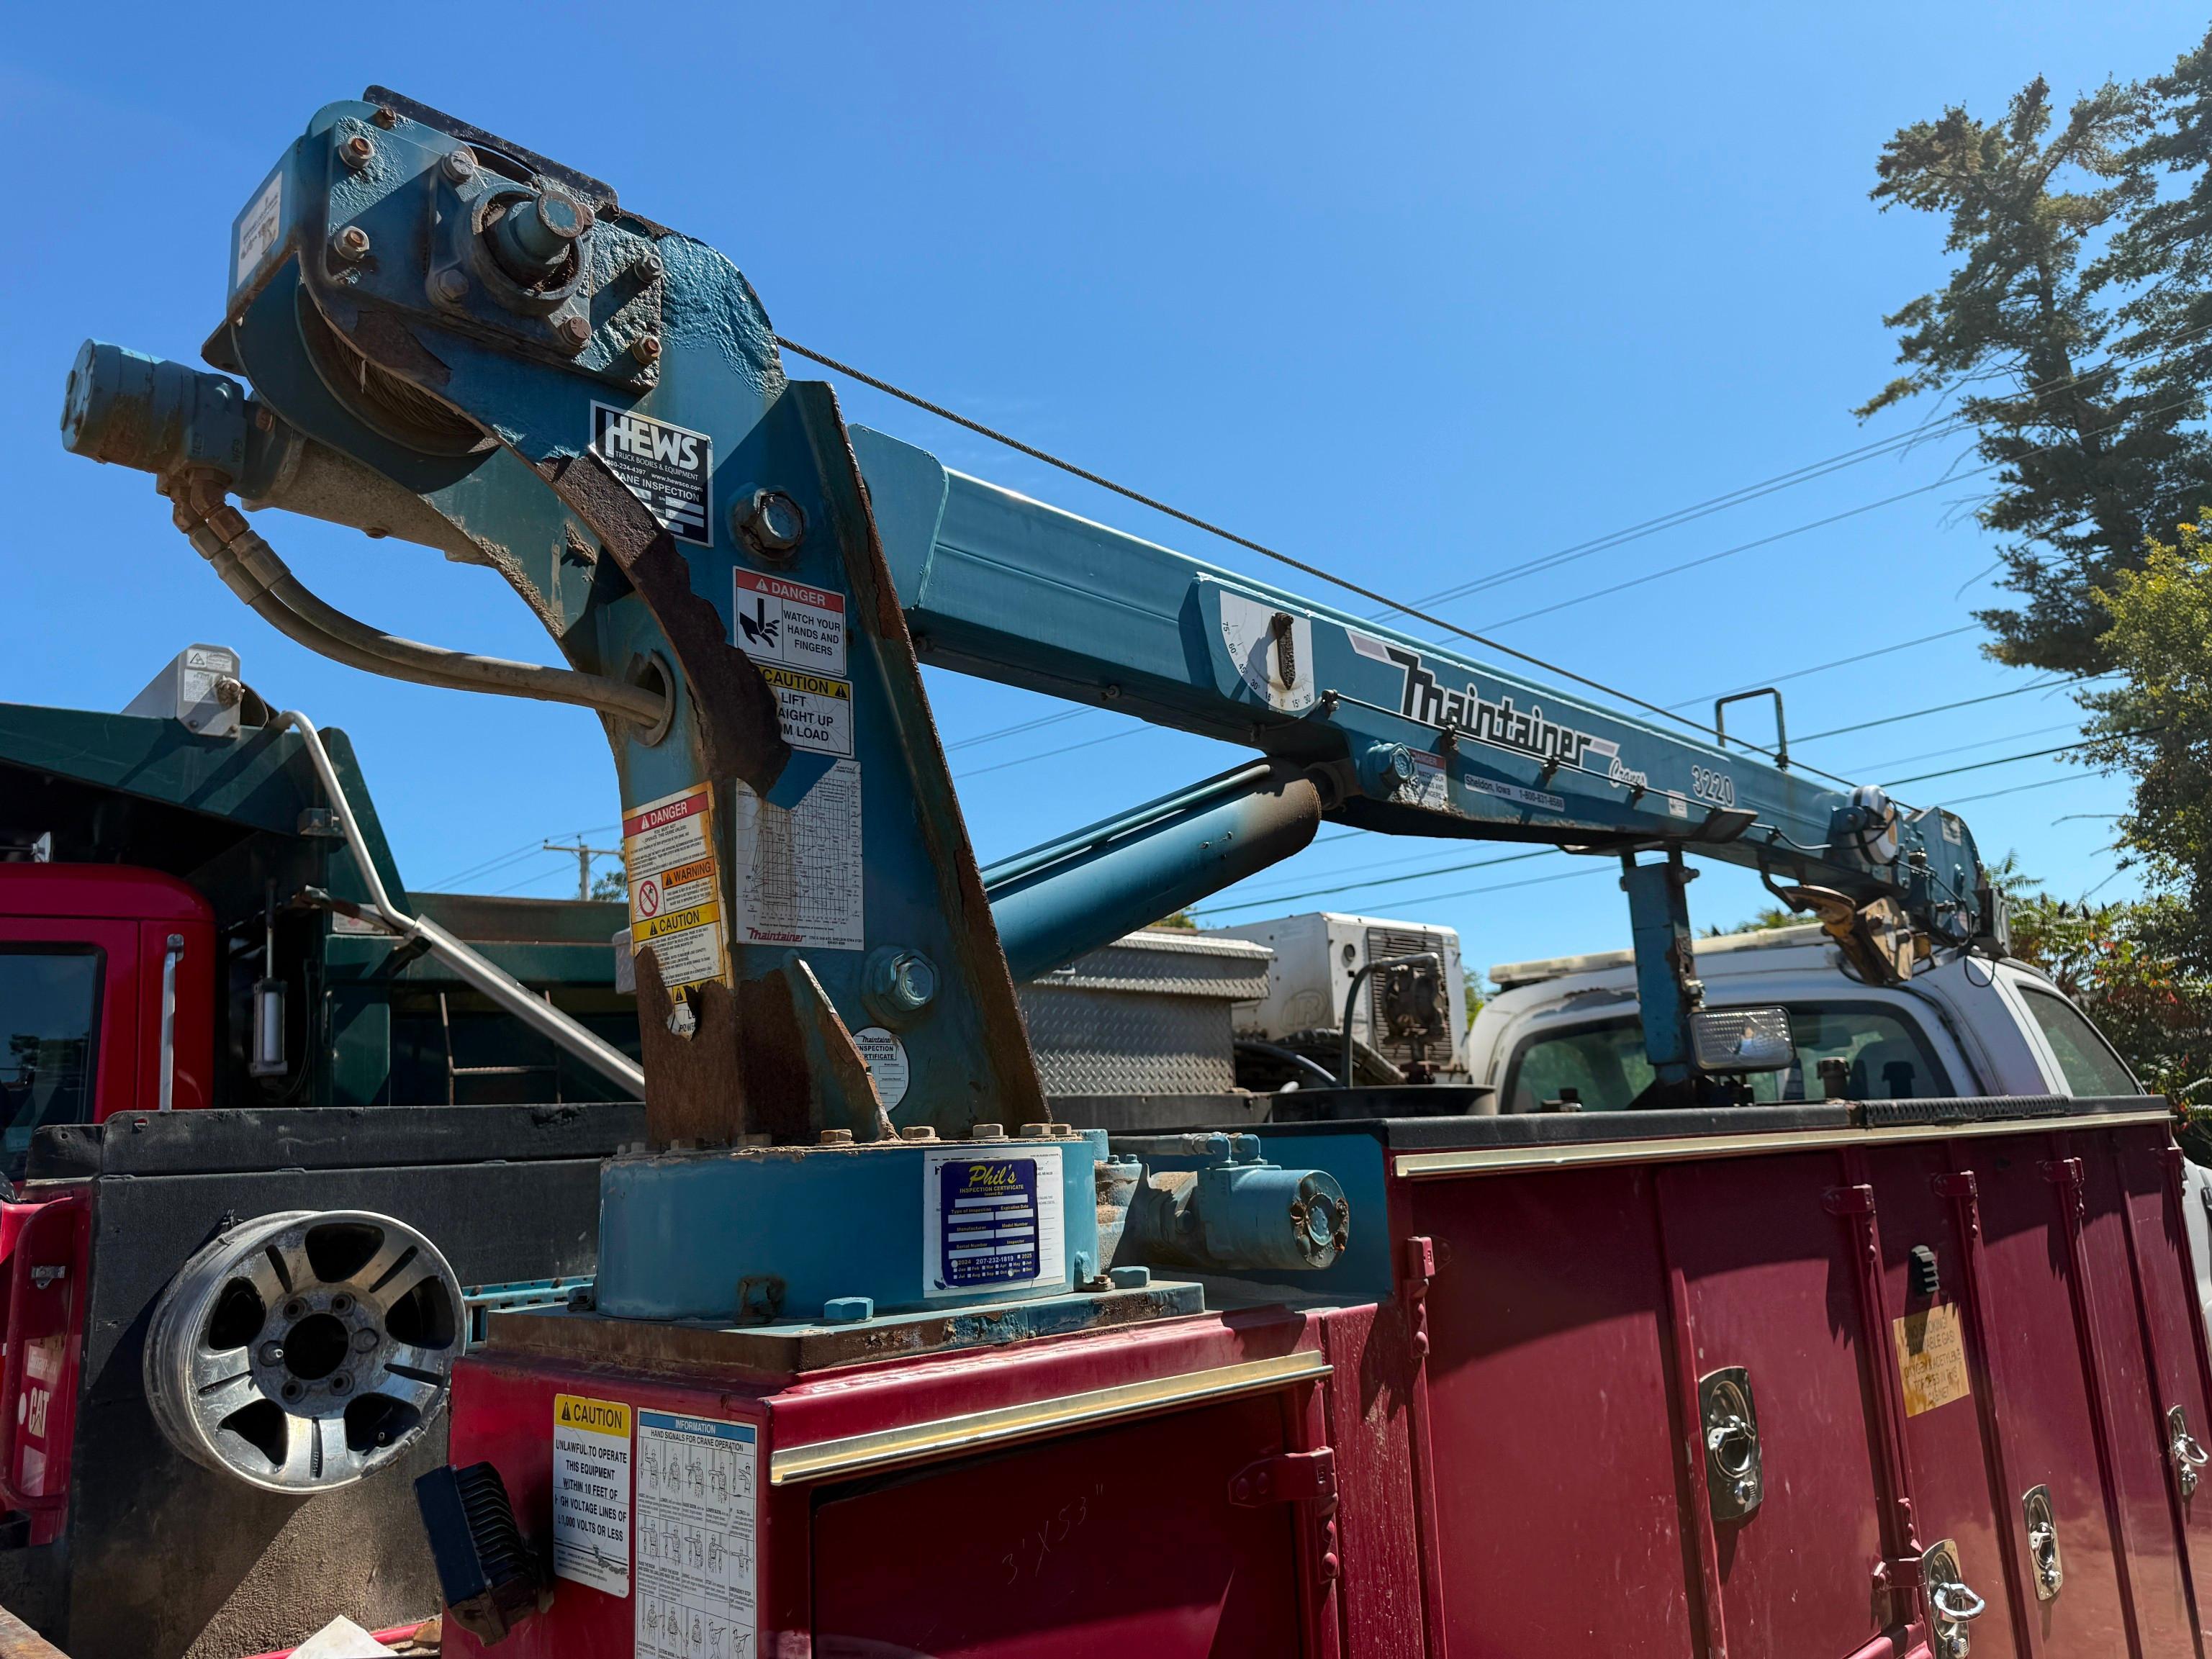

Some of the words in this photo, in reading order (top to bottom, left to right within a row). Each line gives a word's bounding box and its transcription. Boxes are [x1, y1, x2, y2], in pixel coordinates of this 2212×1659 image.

[605, 412, 699, 470] HEWS
[615, 451, 635, 463] TRUCK
[636, 457, 658, 469] BODIES
[665, 466, 698, 481] EQUIPMENT
[643, 479, 700, 502] INSPECTION
[651, 473, 703, 492] www.hewsco.com
[772, 582, 826, 606] DANGER
[784, 610, 814, 624] WATCH
[816, 618, 841, 632] YOUR
[787, 625, 818, 639] HANDS
[821, 632, 839, 644] AND
[795, 639, 833, 656] FINGERS
[763, 669, 828, 694] CAUTION
[782, 692, 806, 707] LIFT
[1382, 643, 1595, 768] Maintainer
[778, 708, 814, 723] AIGHT
[818, 715, 834, 726] UP
[798, 726, 829, 741] LOAD
[1609, 756, 1647, 788] Cranes
[1466, 775, 1495, 792] Sheldon,
[1496, 783, 1511, 795] Iowa
[1692, 764, 1735, 807] 3220
[651, 801, 687, 826] DANGER
[674, 862, 710, 882] WARNING
[659, 910, 700, 931] CAUTION
[746, 927, 806, 942] Maintainer
[679, 1023, 696, 1031] POWE
[969, 1164, 1016, 1187] Phil's
[976, 1256, 1014, 1265] 207-232-1819
[29, 1387, 50, 1439] CAT
[574, 1404, 622, 1429] CAUTION
[675, 1419, 715, 1434] INFORMATION
[556, 1439, 587, 1455] UNLAWFUL
[589, 1445, 596, 1457] TO
[599, 1448, 627, 1463] OPERATE
[664, 1432, 685, 1442] SIGNALS
[697, 1437, 713, 1447] CRANE
[715, 1440, 744, 1452] OPERATION
[566, 1460, 579, 1472] THIS
[581, 1463, 615, 1480] EQUIPMENT
[563, 1478, 583, 1493] WITHIN
[584, 1482, 590, 1493] 10
[593, 1486, 608, 1498] FEET
[610, 1489, 618, 1500] OF
[555, 1494, 569, 1507] HGH
[570, 1497, 597, 1515] VOLTAGE
[599, 1506, 616, 1520] LINES
[618, 1510, 626, 1523] OF
[577, 1518, 596, 1534] VOLTS
[597, 1525, 606, 1537] OR
[608, 1527, 623, 1542] LESS
